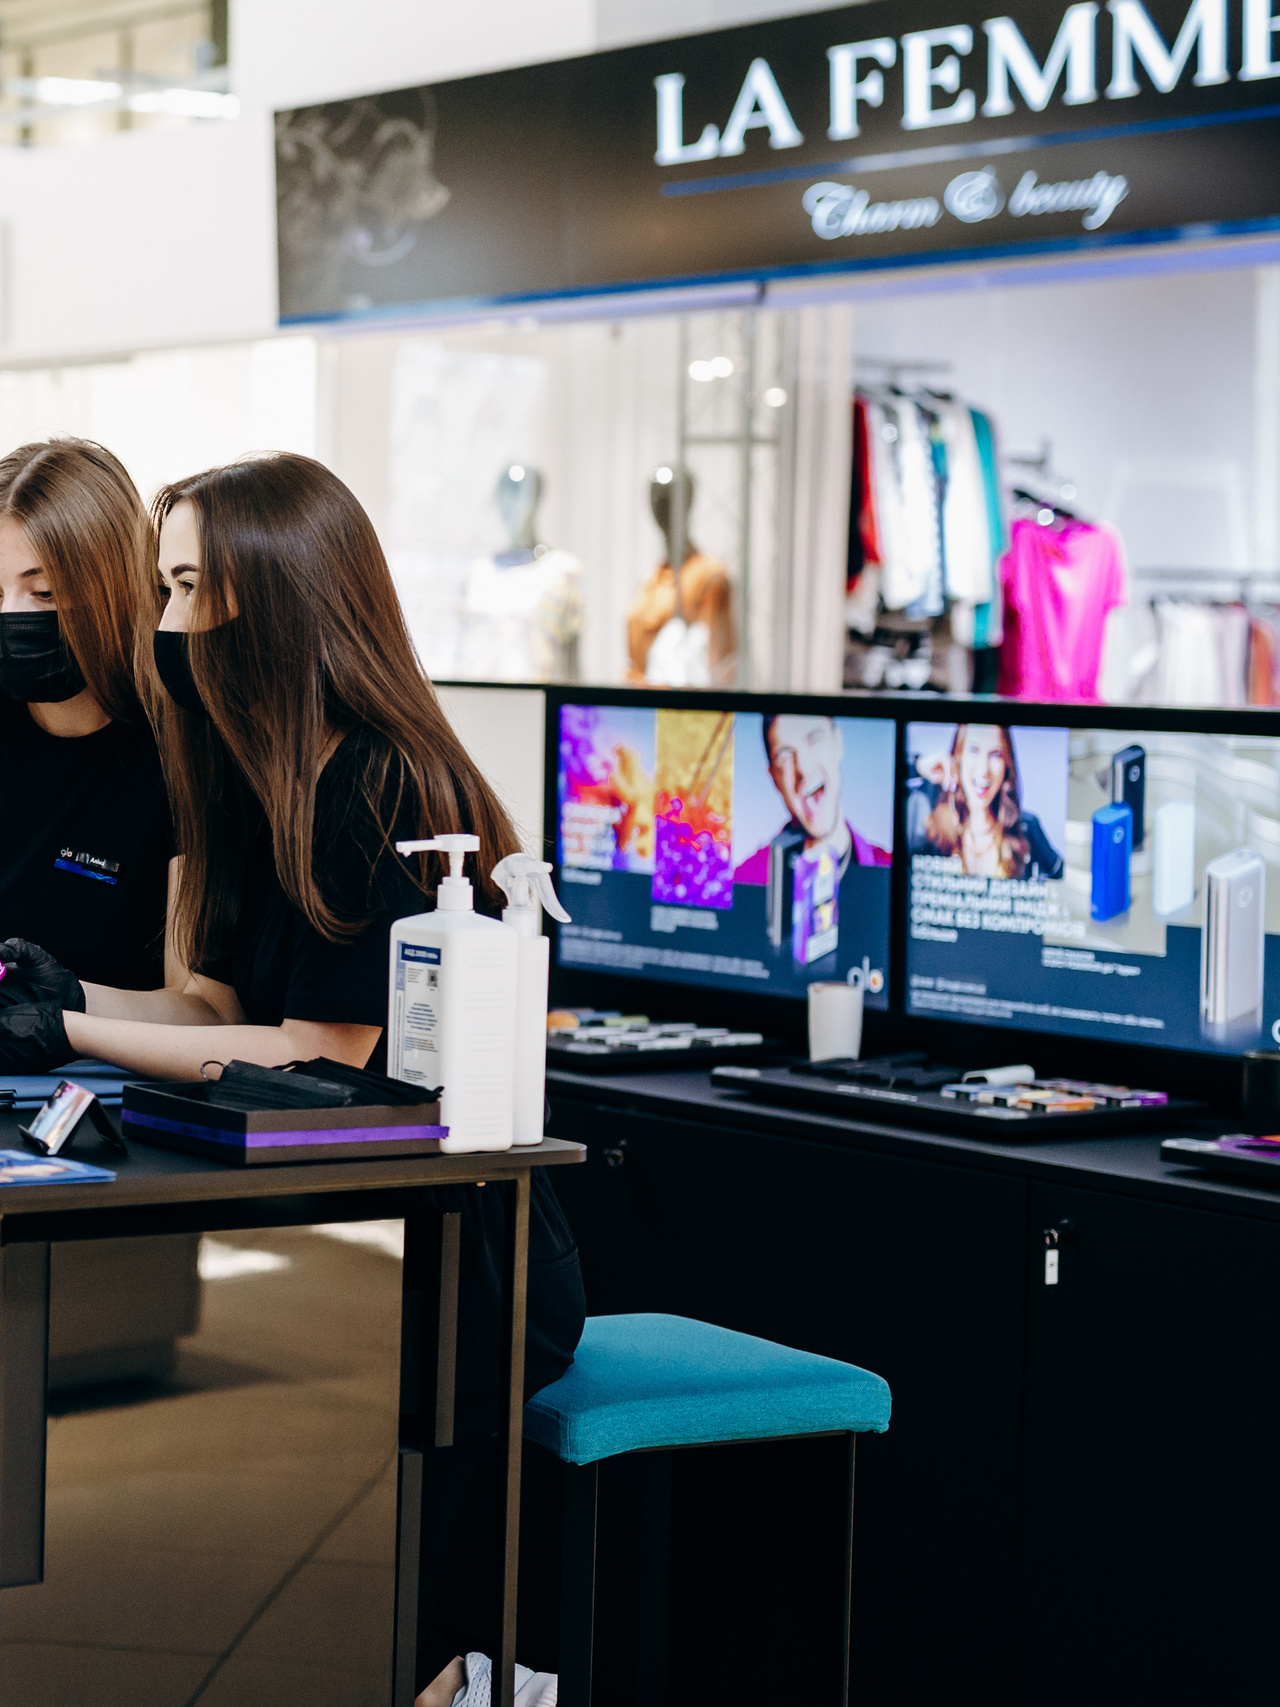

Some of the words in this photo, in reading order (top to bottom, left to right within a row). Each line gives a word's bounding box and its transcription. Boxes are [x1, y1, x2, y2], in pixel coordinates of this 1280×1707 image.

[654, 57, 805, 166] LA
[802, 181, 944, 240] Charm
[1007, 170, 1130, 231] beauty
